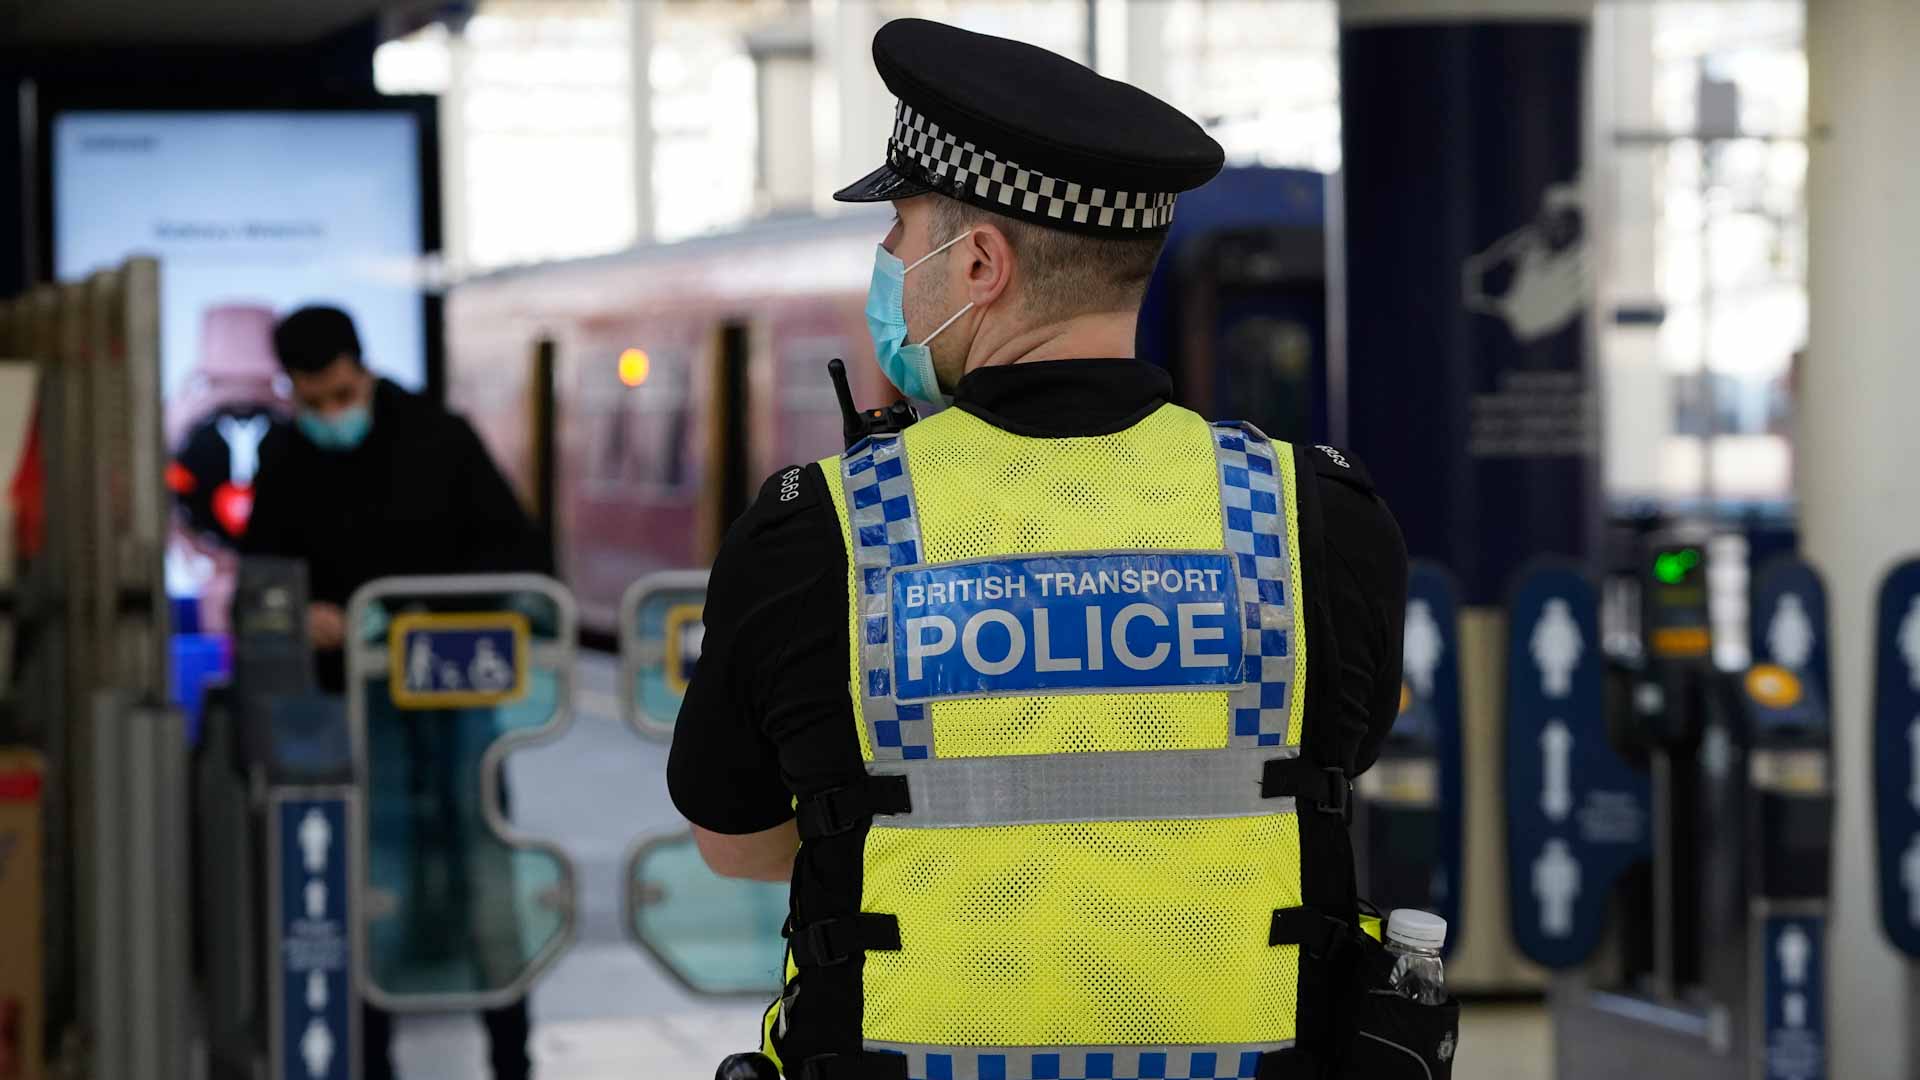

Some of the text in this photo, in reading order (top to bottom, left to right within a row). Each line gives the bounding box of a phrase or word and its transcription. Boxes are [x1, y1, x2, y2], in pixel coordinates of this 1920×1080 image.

[780, 468, 800, 501] 6569
[906, 569, 1222, 608] BRITISH TRANSPORT
[906, 602, 1229, 681] POLICE
